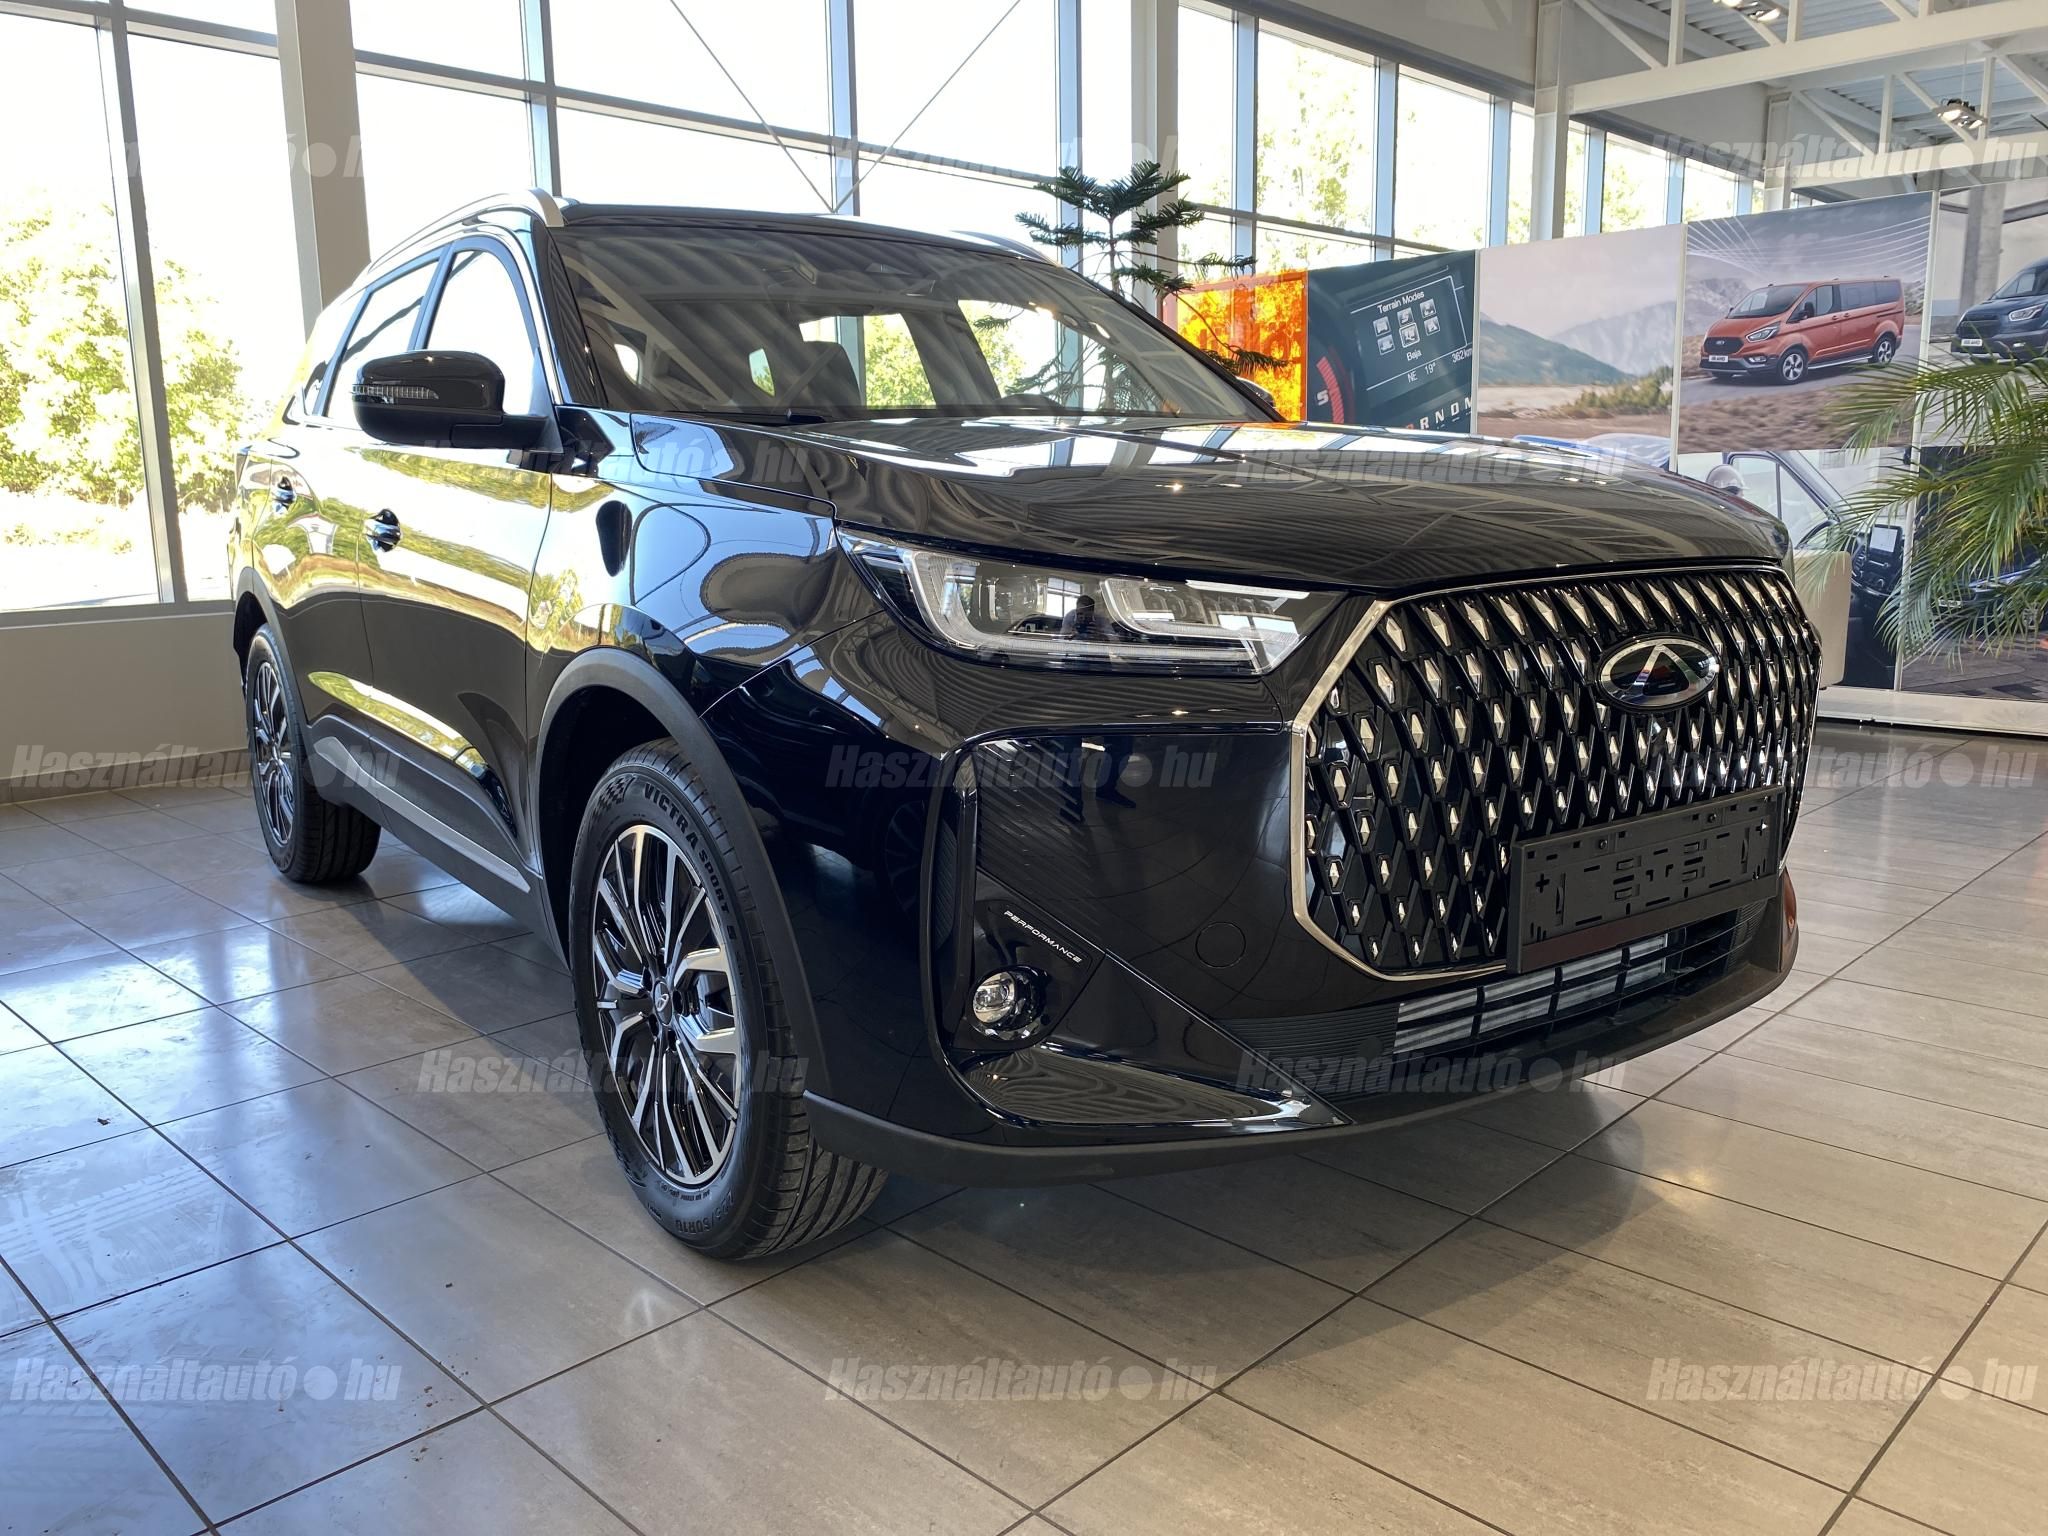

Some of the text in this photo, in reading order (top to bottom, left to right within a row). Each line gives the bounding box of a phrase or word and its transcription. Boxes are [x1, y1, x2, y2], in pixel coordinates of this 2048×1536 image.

[1377, 290, 1425, 314] Terrain Modes
[643, 782, 700, 850] VICTRA
[1003, 910, 1083, 963] PERFORMANCE
